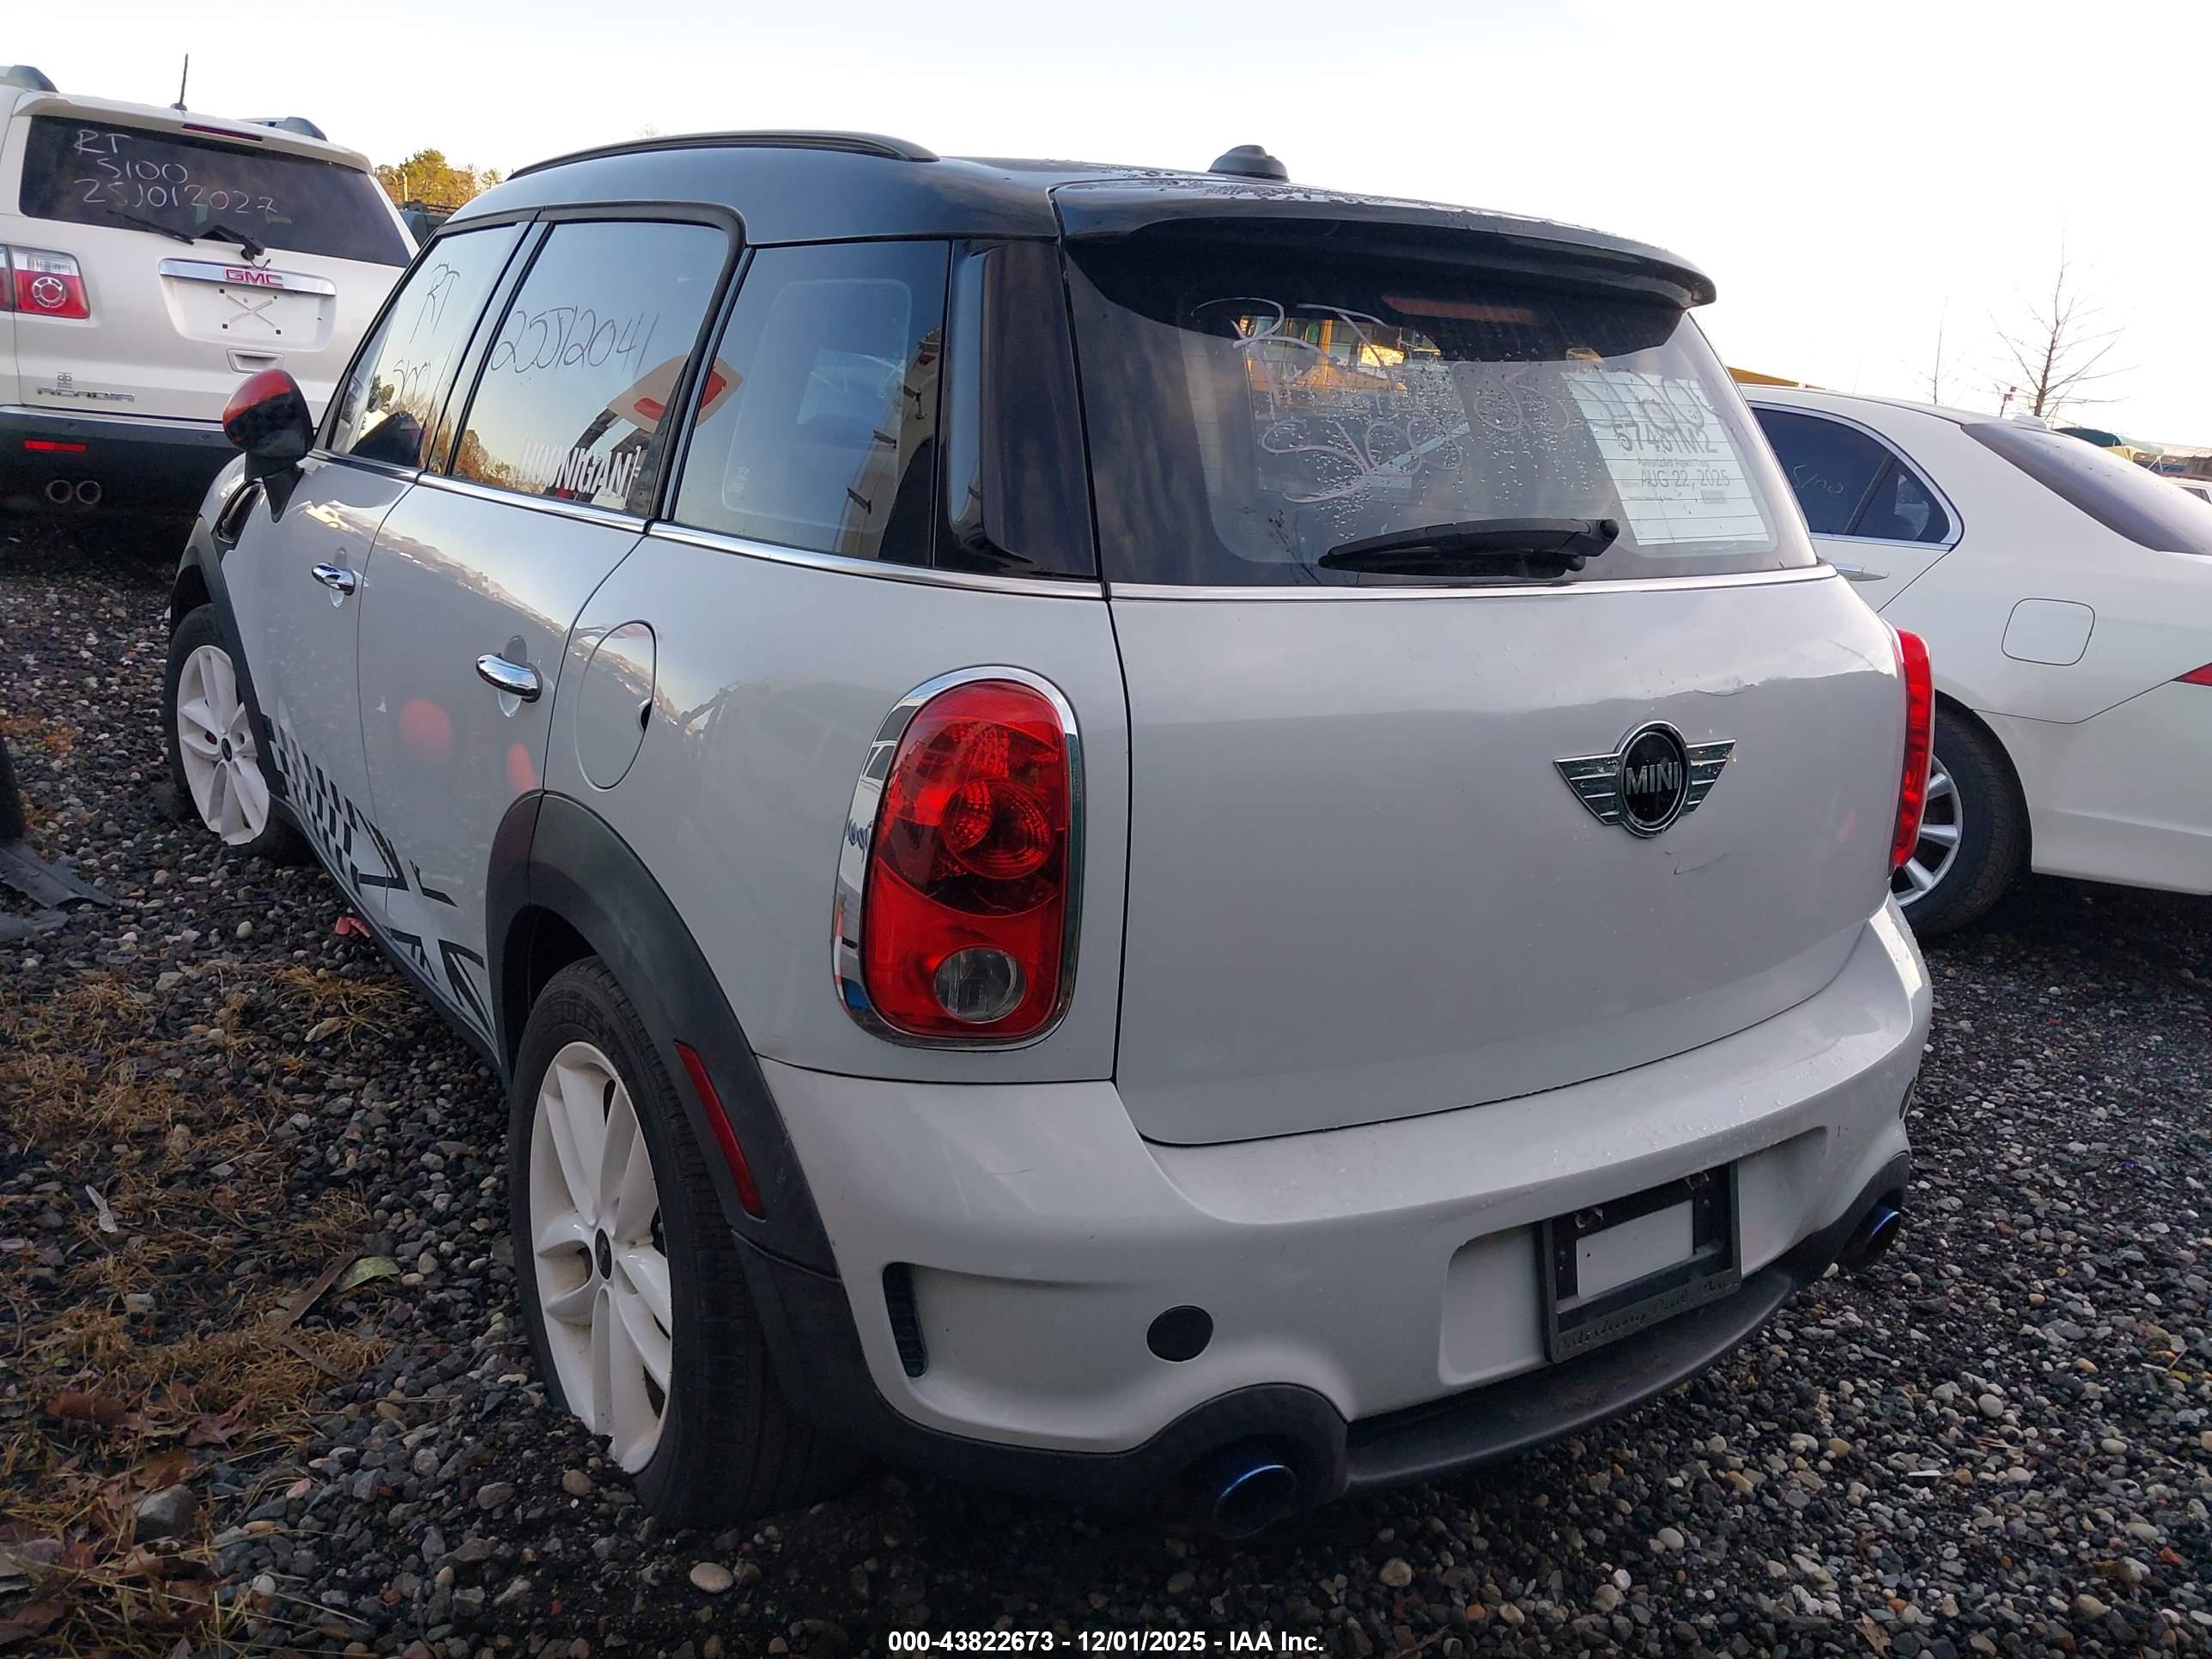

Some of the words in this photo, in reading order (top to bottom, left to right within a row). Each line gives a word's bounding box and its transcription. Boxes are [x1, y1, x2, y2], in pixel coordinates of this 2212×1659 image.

[225, 269, 284, 289] GMC
[1641, 469, 1670, 488] AUG
[1697, 469, 1731, 487] 2025
[1626, 762, 1679, 796] MINI
